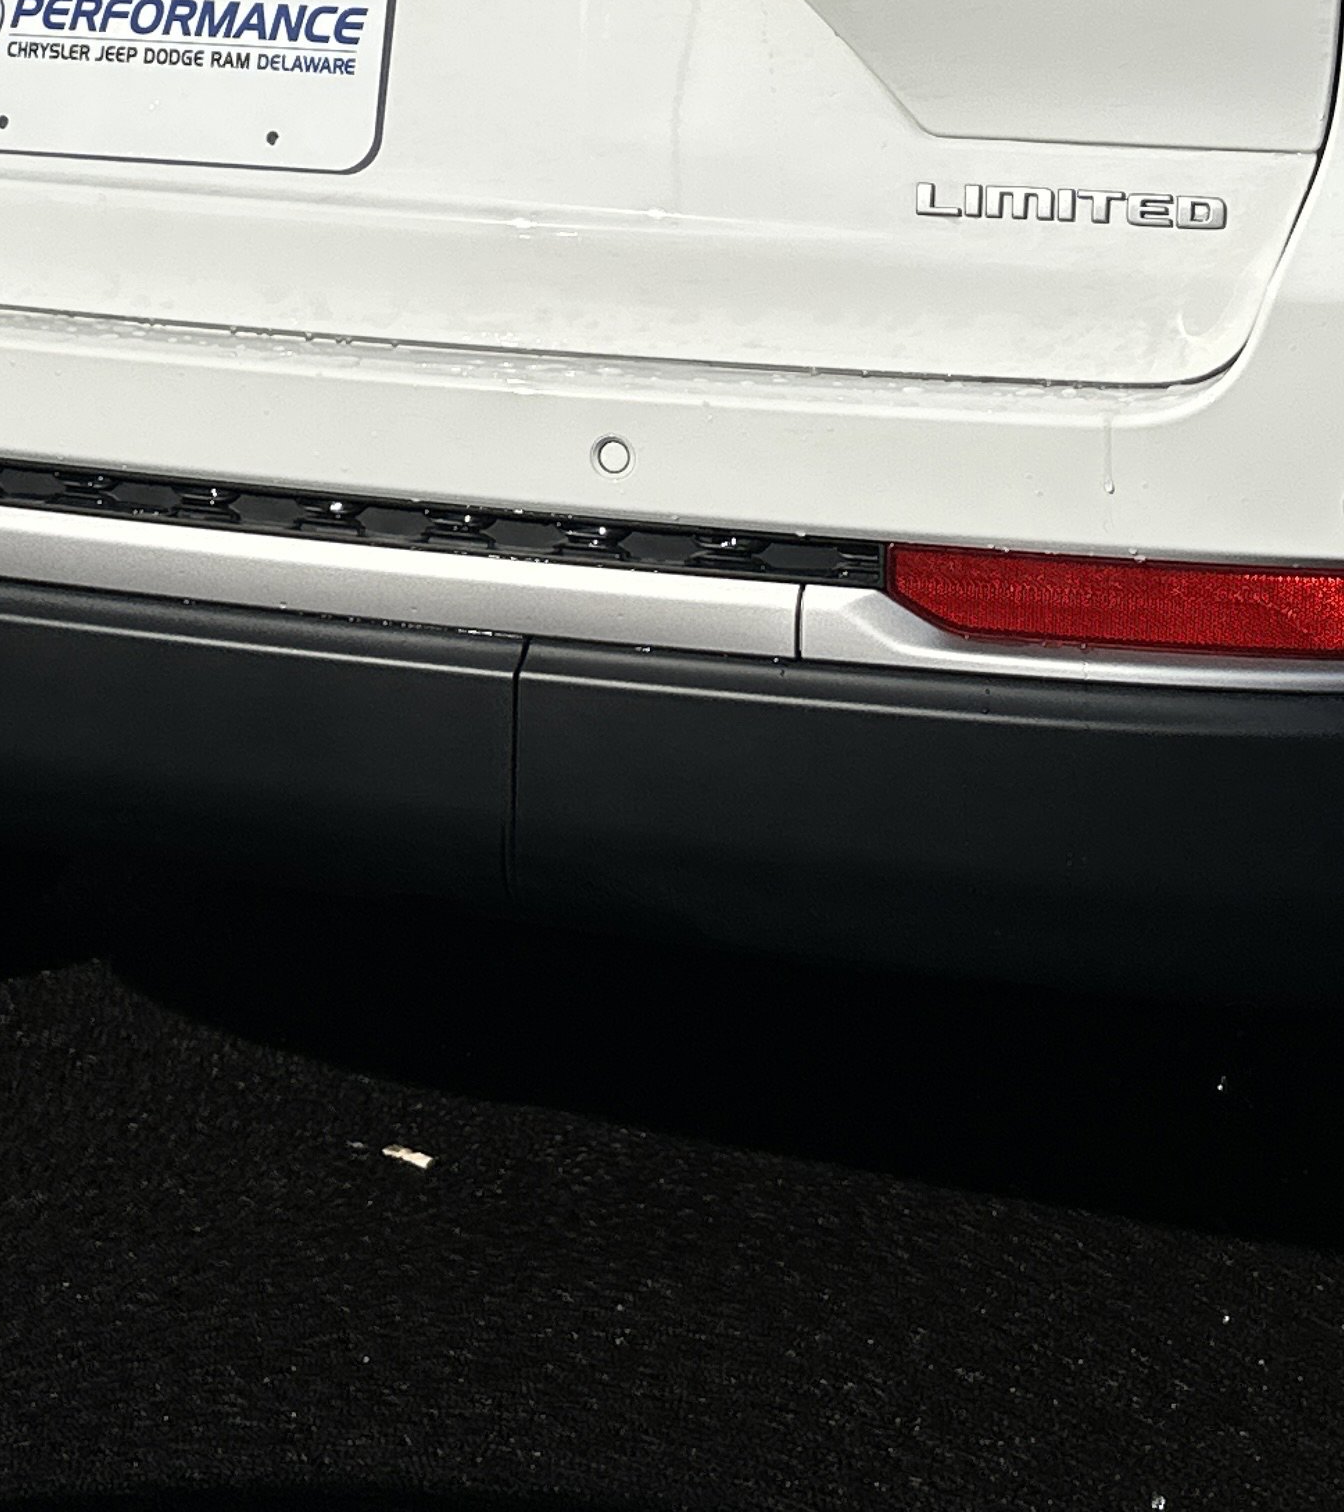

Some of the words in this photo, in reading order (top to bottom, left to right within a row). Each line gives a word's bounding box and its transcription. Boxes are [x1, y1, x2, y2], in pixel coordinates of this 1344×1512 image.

[7, 41, 90, 61] CHRYSLER
[94, 47, 138, 63] JEEP
[143, 48, 204, 67] DODGE
[210, 52, 250, 70] RAM
[256, 54, 356, 75] DELAWARE
[915, 182, 1228, 230] LIMITED
